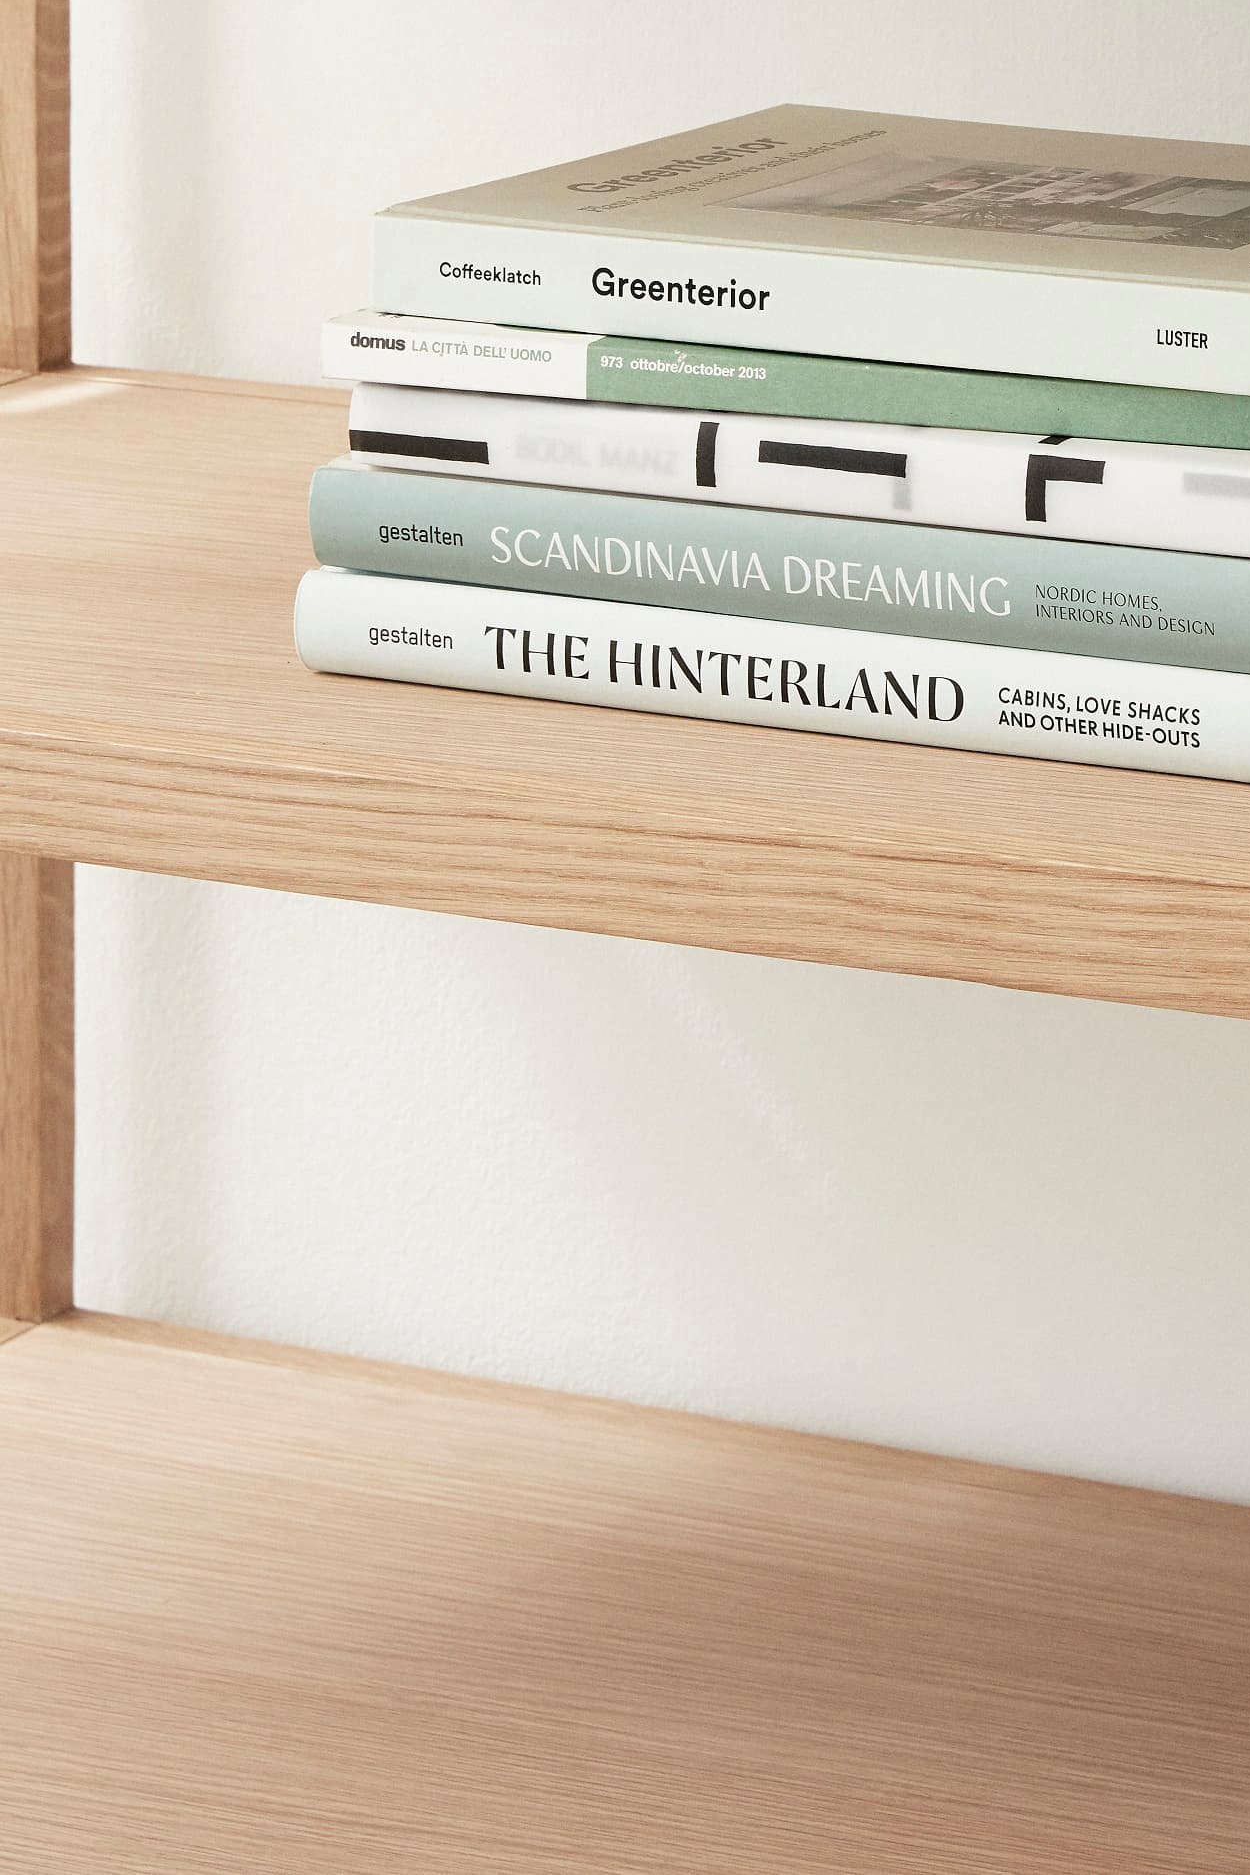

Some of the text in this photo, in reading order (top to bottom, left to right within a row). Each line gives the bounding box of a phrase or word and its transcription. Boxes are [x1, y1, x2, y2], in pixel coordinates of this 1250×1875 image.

[567, 137, 788, 193] Greenterior
[439, 261, 1208, 349] Coffeeklatch Greenterior LUSTER
[350, 331, 406, 351] domus
[411, 340, 429, 353] LA
[431, 340, 469, 356] CITTÀ
[600, 355, 624, 369] 973
[630, 357, 735, 378] ottobre/october
[738, 366, 767, 380] 2013
[378, 521, 1012, 617] gestalten SCANDINAVIA DREAMING
[1035, 584, 1162, 613] NORDIC HOMES,
[1036, 604, 1216, 637] INTERIORS AND DESIGN
[368, 624, 965, 723] gestalten THE HINTERLAND
[998, 687, 1201, 726] CABINS, LOVE SHACKS
[998, 710, 1201, 749] AND OTHER HIDE-OUTS
